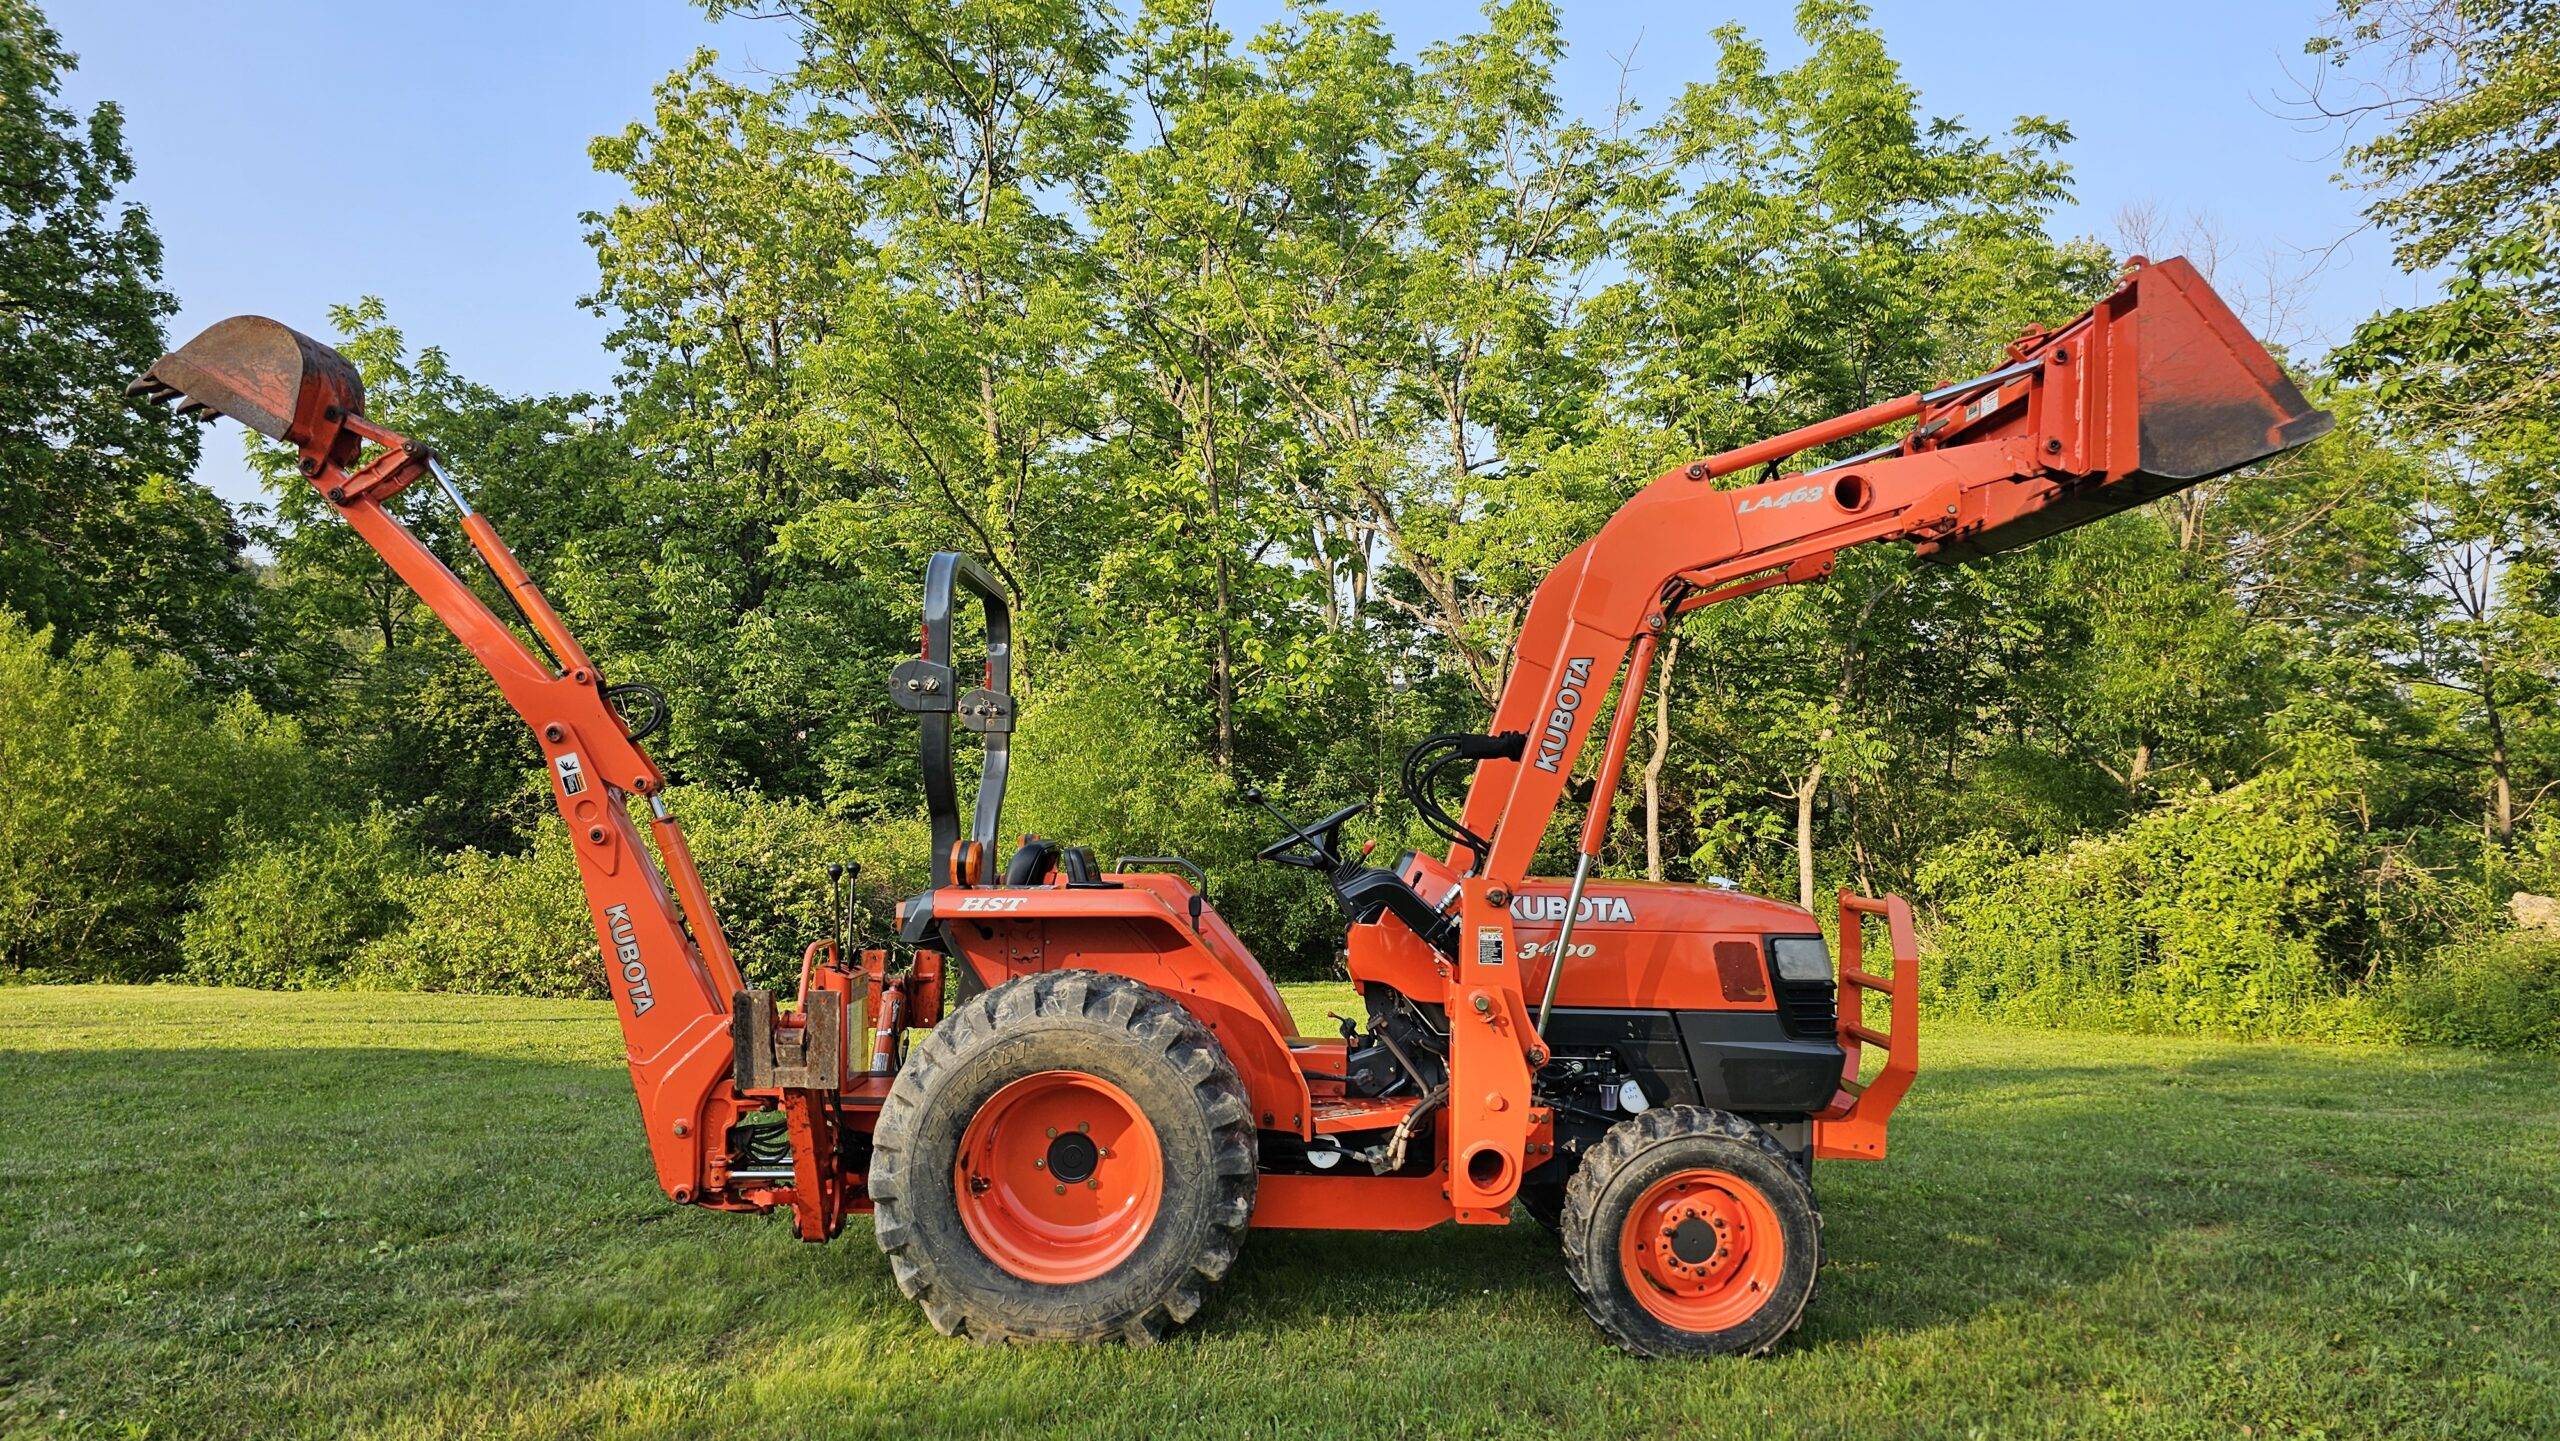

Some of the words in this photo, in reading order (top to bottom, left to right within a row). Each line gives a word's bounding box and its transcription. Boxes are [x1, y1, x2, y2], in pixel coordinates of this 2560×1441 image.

[1737, 486, 1825, 515] LA463
[1534, 656, 1595, 774] KUBOTA
[957, 897, 1027, 912] HST
[1509, 894, 1635, 923] KUBOTA
[604, 903, 656, 1018] KUBOTA
[925, 1040, 1027, 1143] TITAN
